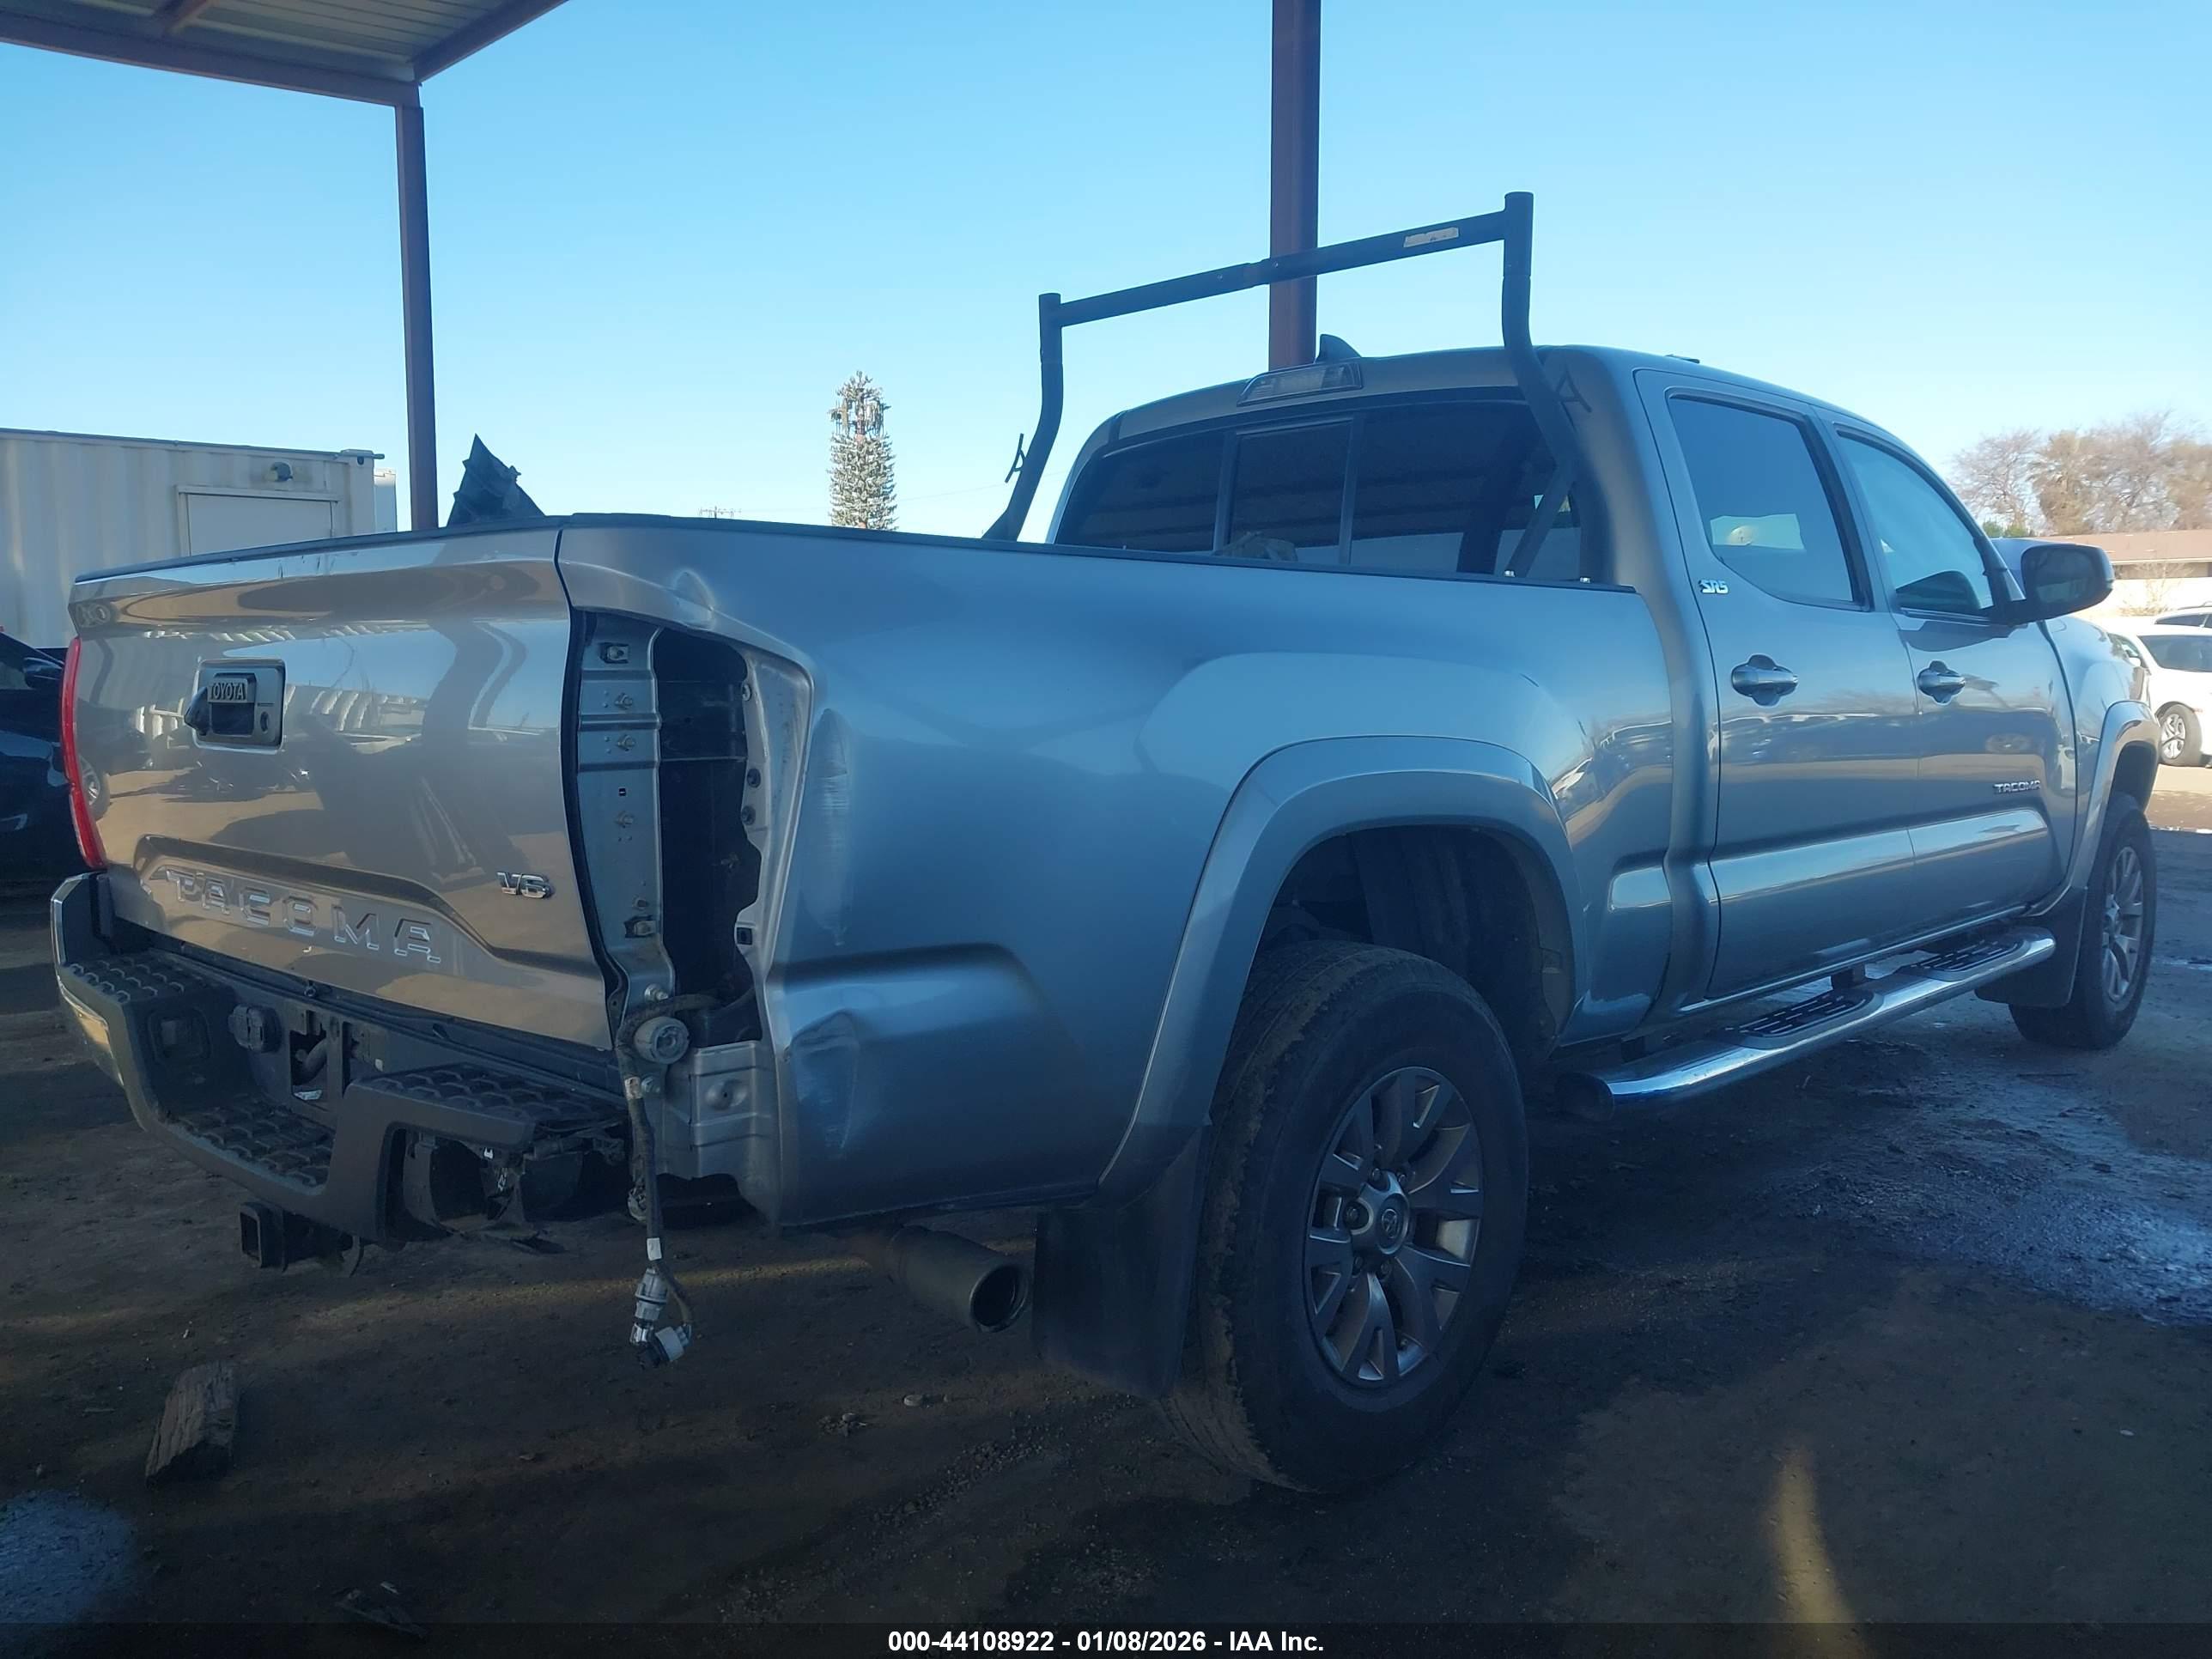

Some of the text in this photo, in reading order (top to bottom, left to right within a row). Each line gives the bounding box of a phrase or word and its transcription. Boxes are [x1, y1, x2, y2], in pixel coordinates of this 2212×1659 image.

[1698, 580, 1729, 594] SR5
[208, 682, 246, 701] TOYOTA
[1993, 780, 2041, 793] TACOMA
[496, 871, 550, 898] V6
[166, 868, 441, 963] TACOMA
